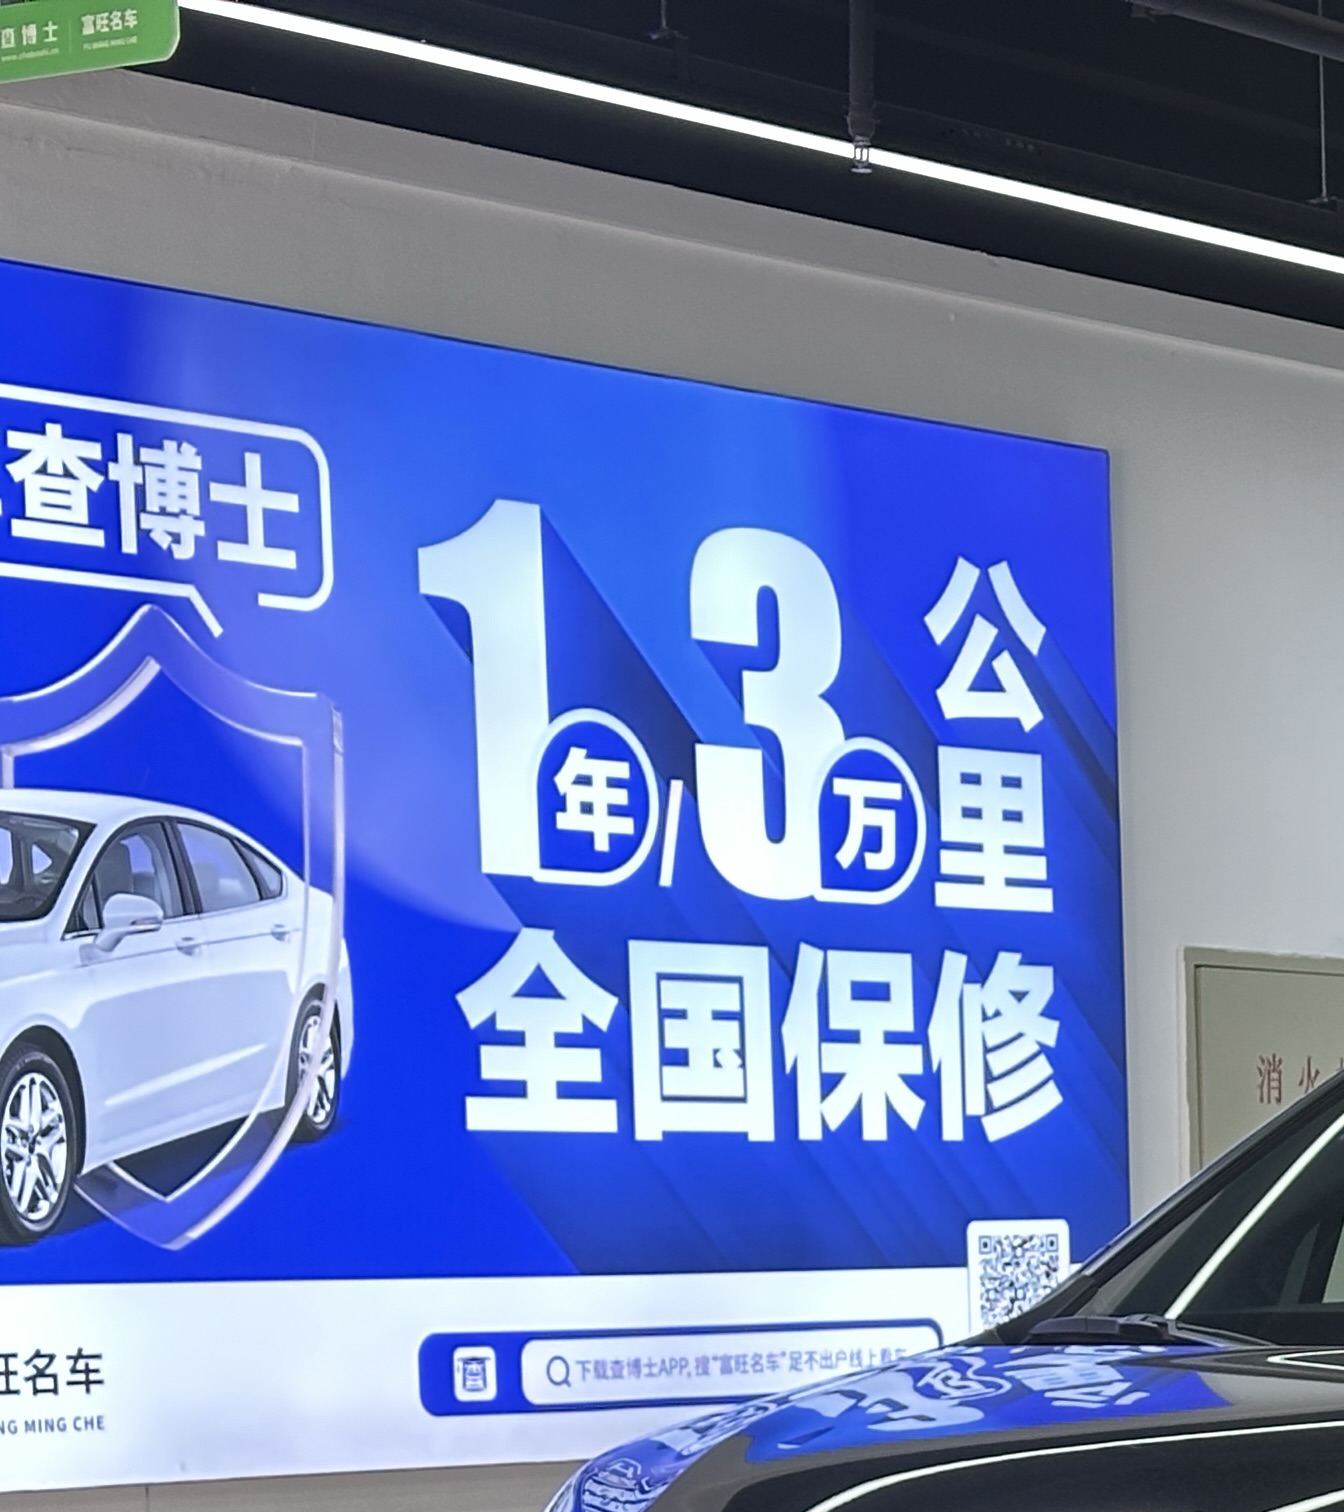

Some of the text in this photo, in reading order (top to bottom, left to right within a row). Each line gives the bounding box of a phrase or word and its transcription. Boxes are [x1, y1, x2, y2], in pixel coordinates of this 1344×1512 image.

[5, 422, 300, 571] 查博士
[455, 927, 1064, 1142] 全国保修
[24, 1417, 67, 1433] MING
[73, 1415, 105, 1432] CHE
